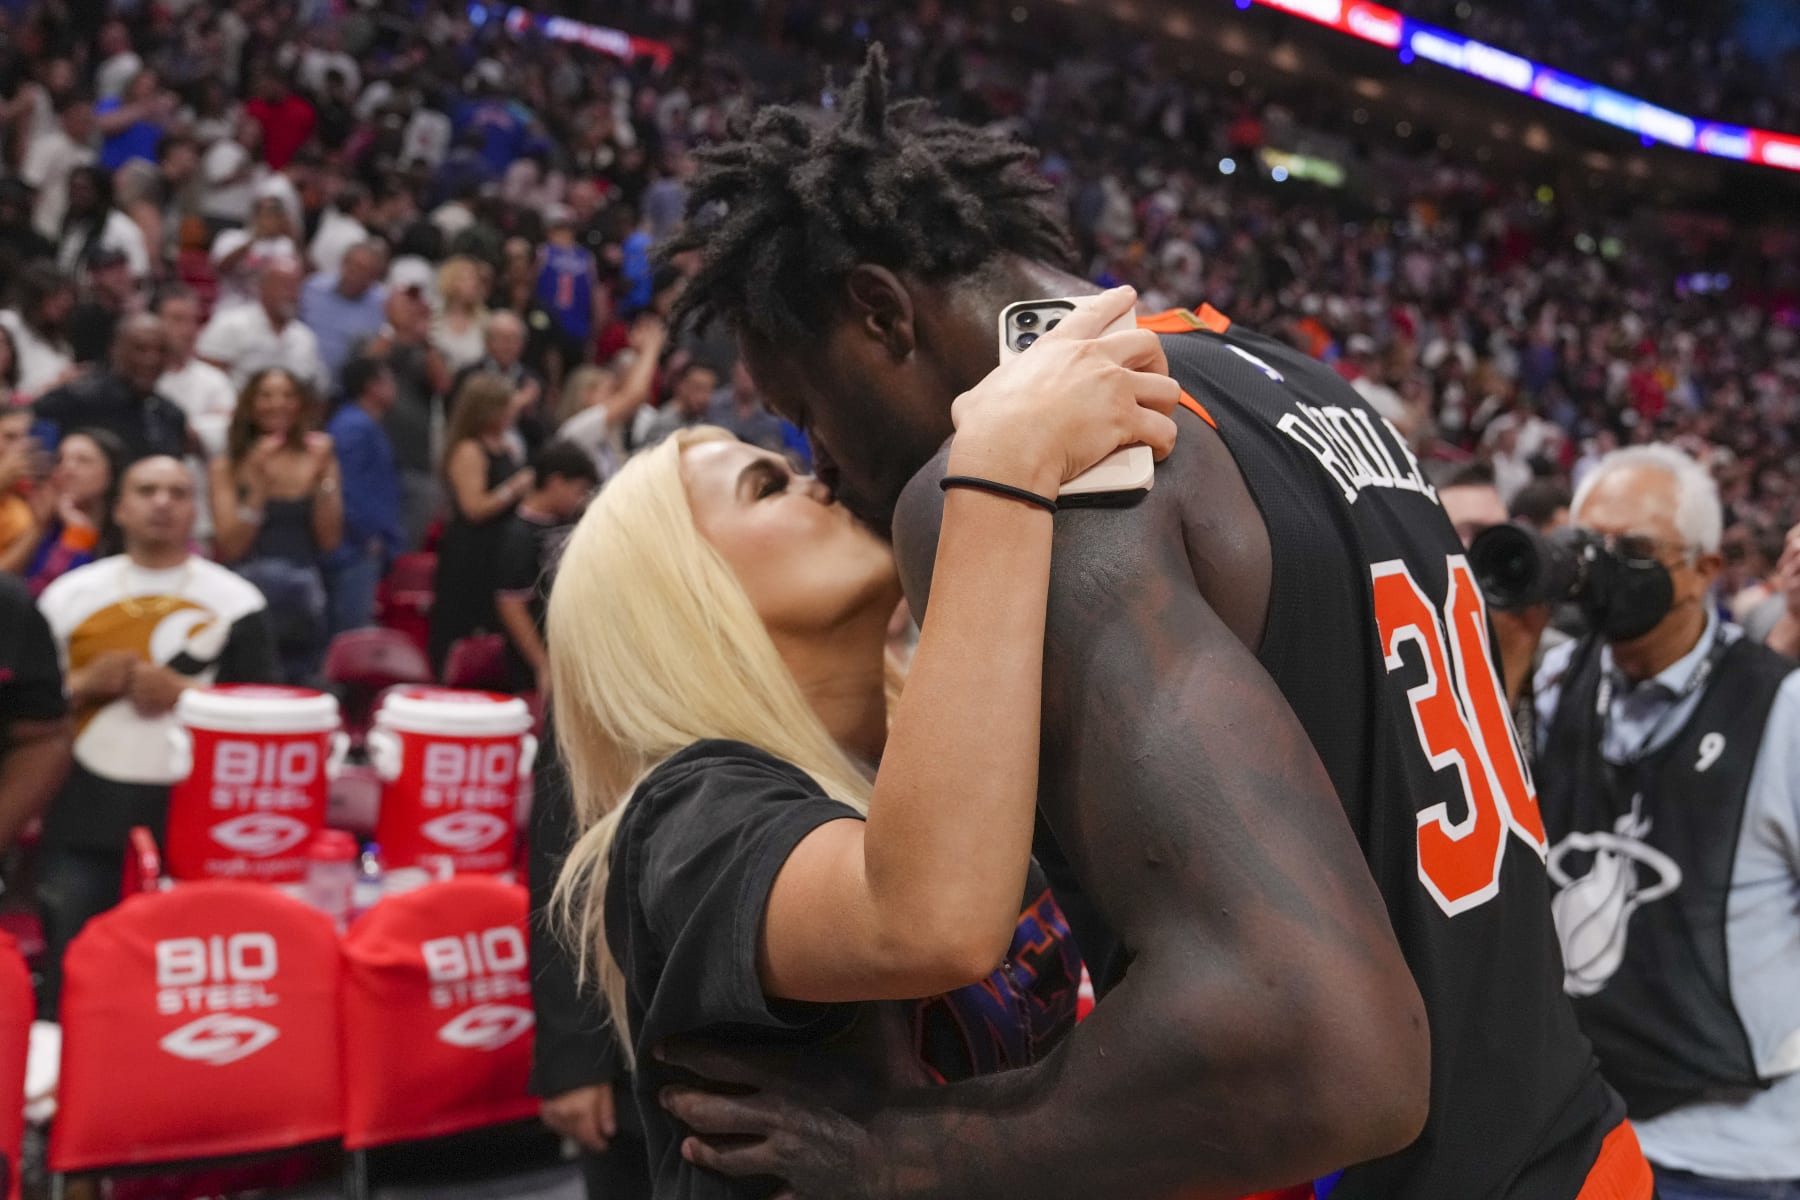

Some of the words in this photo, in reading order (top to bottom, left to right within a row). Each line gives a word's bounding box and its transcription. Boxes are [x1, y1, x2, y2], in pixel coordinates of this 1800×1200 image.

[1276, 401, 1439, 505] RDLE
[1370, 554, 1548, 918] 30
[1695, 732, 1726, 772] 9
[213, 740, 318, 785] BIO
[424, 742, 515, 784] BIO
[210, 785, 313, 810] STEEL
[420, 785, 512, 808] STEEL
[155, 932, 278, 986] BIO
[421, 926, 528, 981] BIO
[156, 980, 279, 1015] STEEL
[430, 974, 532, 1010] STEEL
